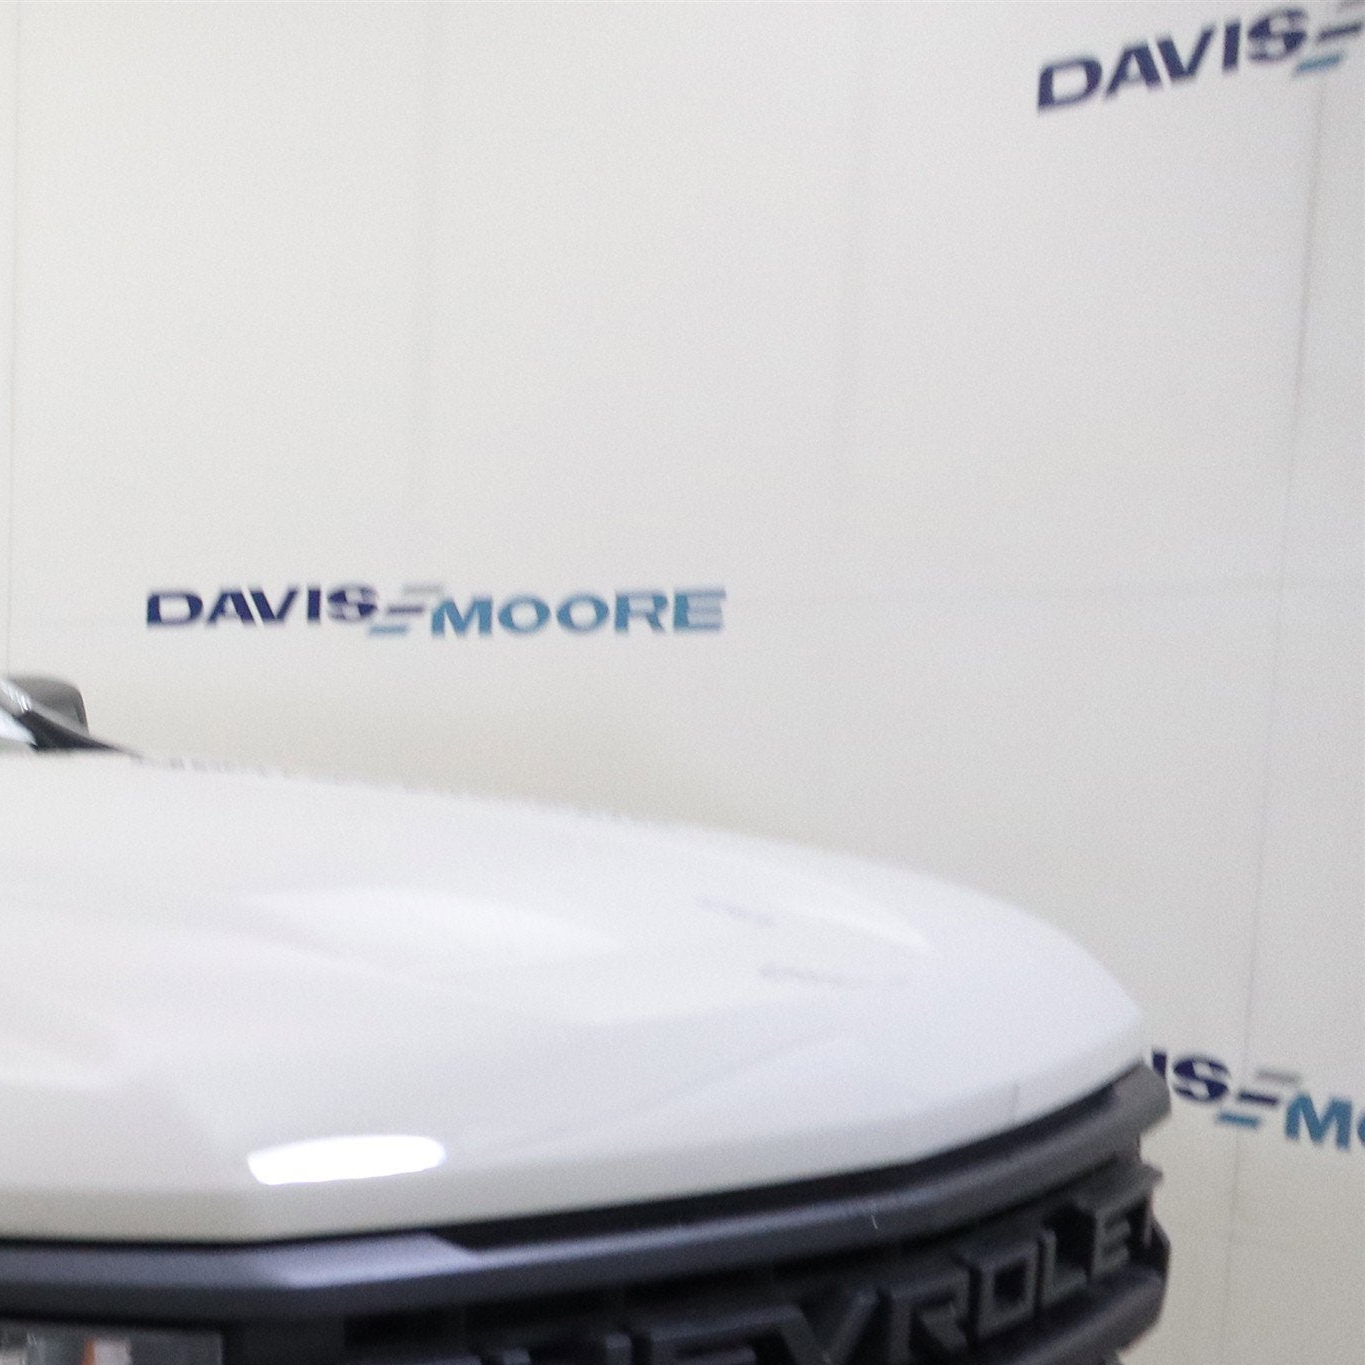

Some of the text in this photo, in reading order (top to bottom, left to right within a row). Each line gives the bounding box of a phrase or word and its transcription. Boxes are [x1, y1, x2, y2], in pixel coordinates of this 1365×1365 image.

[1036, 7, 1308, 113] DAVIS
[145, 582, 727, 638] DAVIS MOORE
